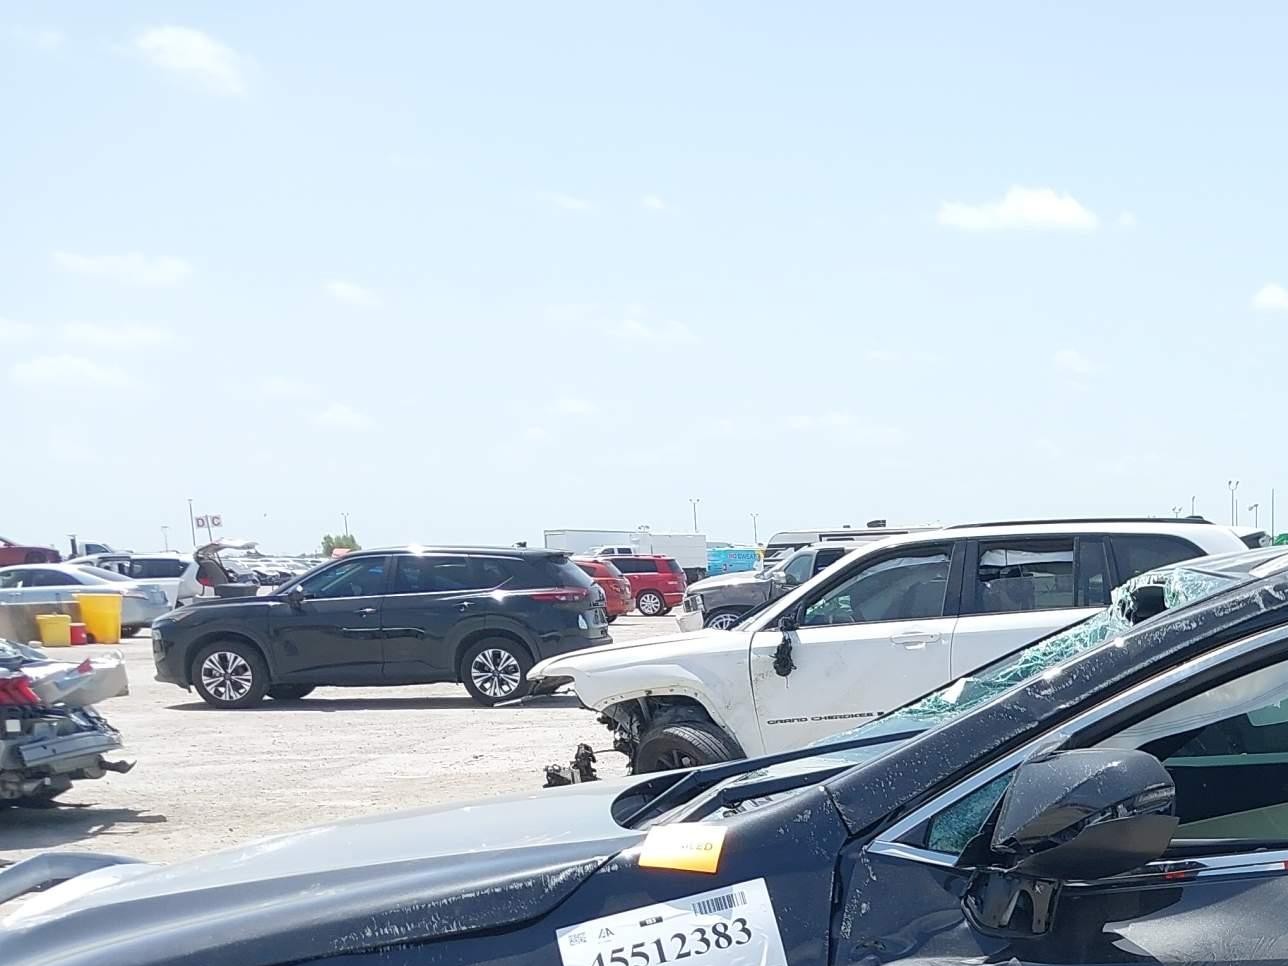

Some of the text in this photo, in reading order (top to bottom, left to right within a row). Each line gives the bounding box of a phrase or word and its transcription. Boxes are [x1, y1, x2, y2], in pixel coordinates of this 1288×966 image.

[196, 516, 221, 527] D C
[767, 712, 873, 725] GRAND CHEROKEE
